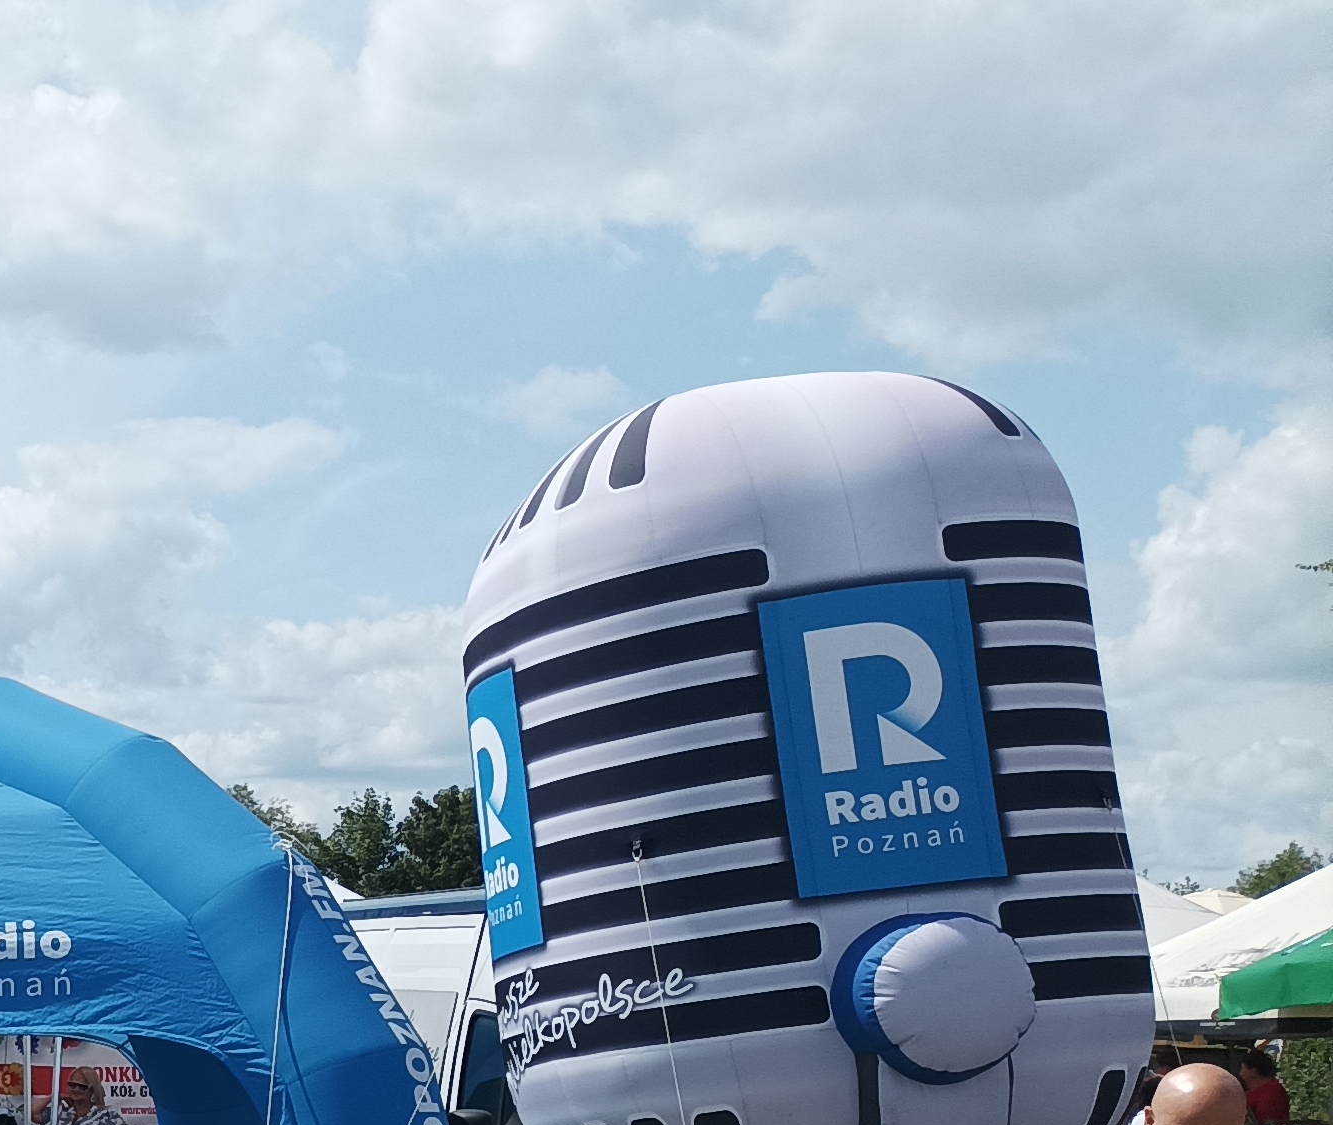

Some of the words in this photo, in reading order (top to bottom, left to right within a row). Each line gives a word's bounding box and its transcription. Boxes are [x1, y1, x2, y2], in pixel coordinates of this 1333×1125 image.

[803, 622, 947, 774] R
[825, 777, 959, 825] Radio
[832, 820, 965, 858] Poznań
[111, 1083, 137, 1097] KÓŁ
